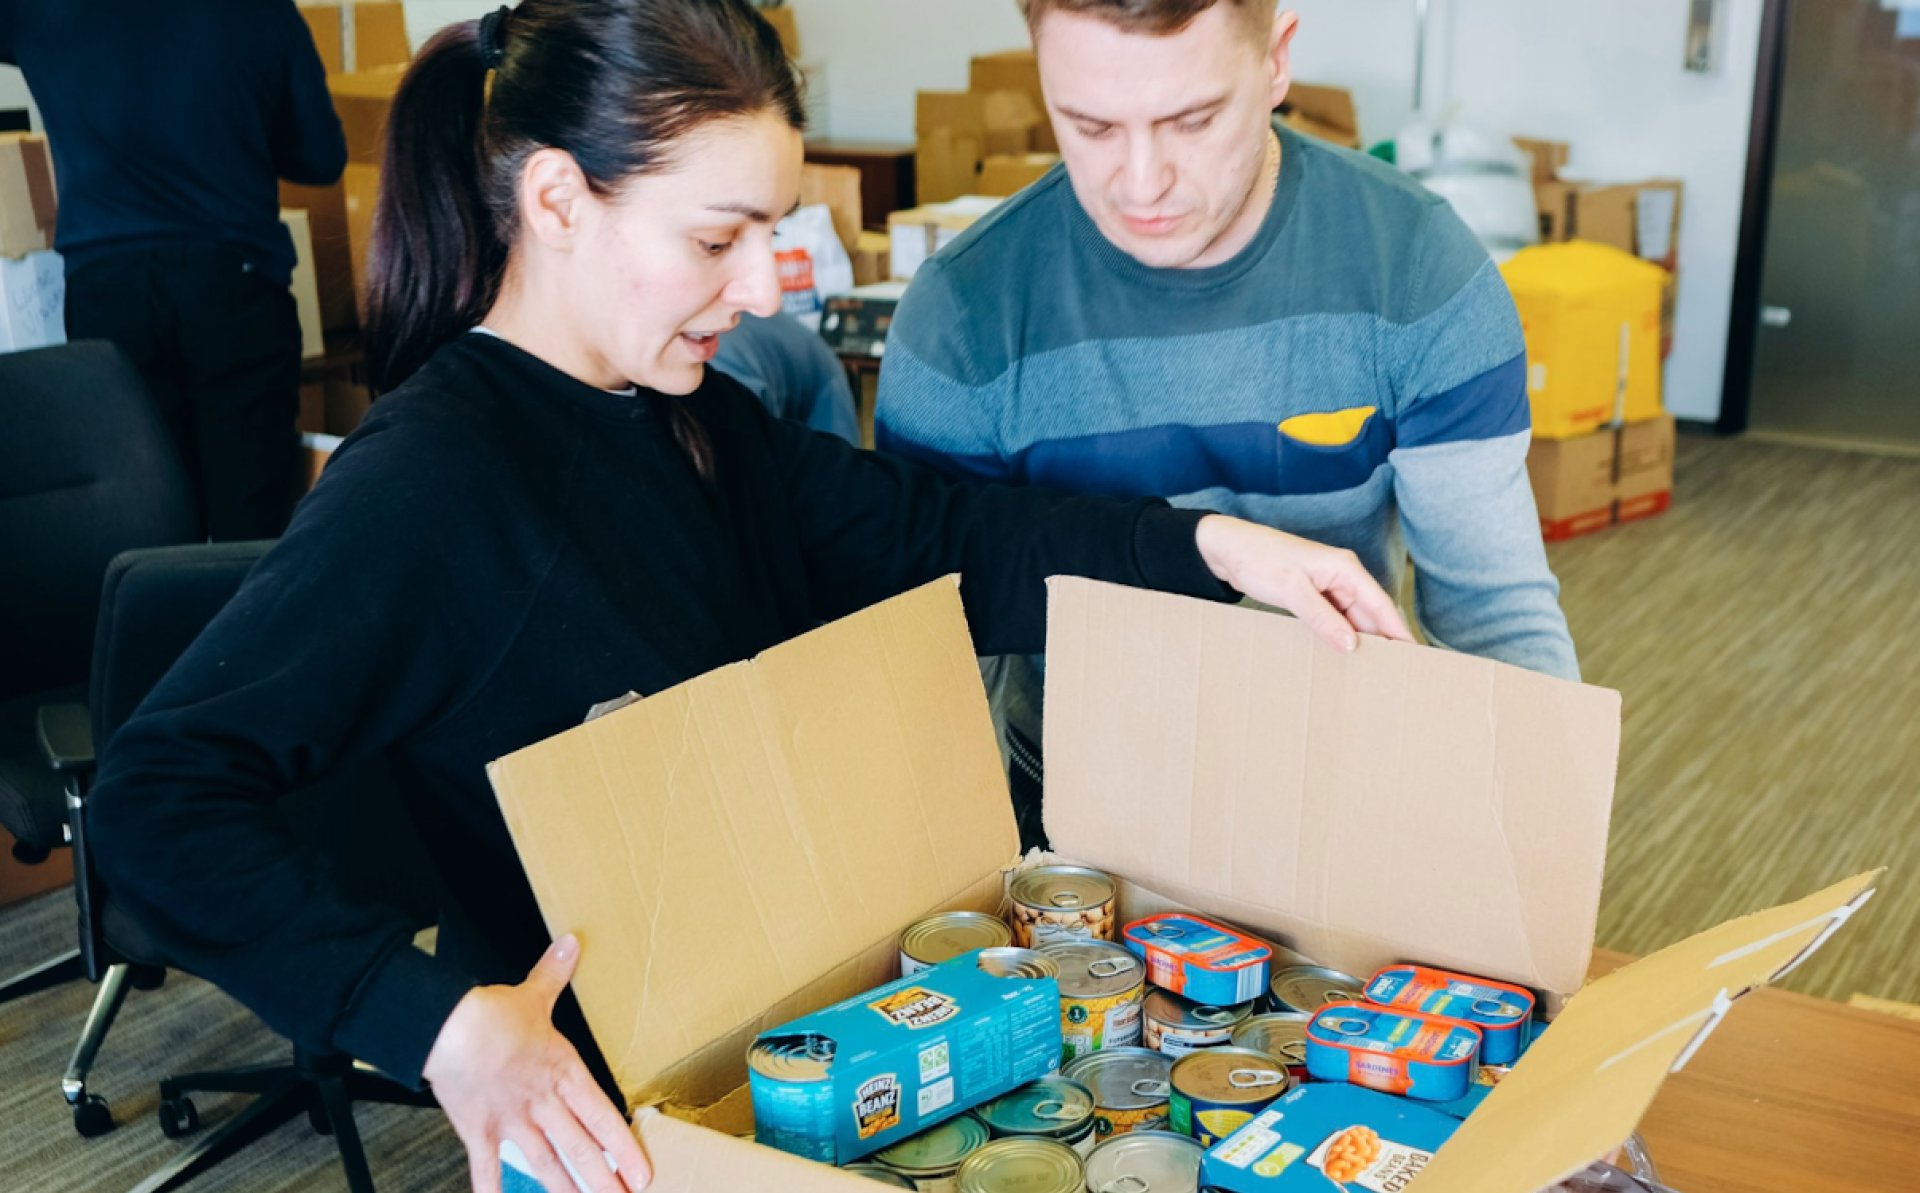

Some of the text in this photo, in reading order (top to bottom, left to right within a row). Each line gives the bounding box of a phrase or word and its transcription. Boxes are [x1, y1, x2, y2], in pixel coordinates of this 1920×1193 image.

[1073, 1008, 1081, 1019] 1
[1355, 1060, 1399, 1076] SARDINES
[860, 1078, 892, 1099] HEINZ
[858, 1092, 897, 1118] BEANZ
[1373, 1153, 1407, 1180] BEANS
[1382, 1152, 1429, 1193] BAKED
